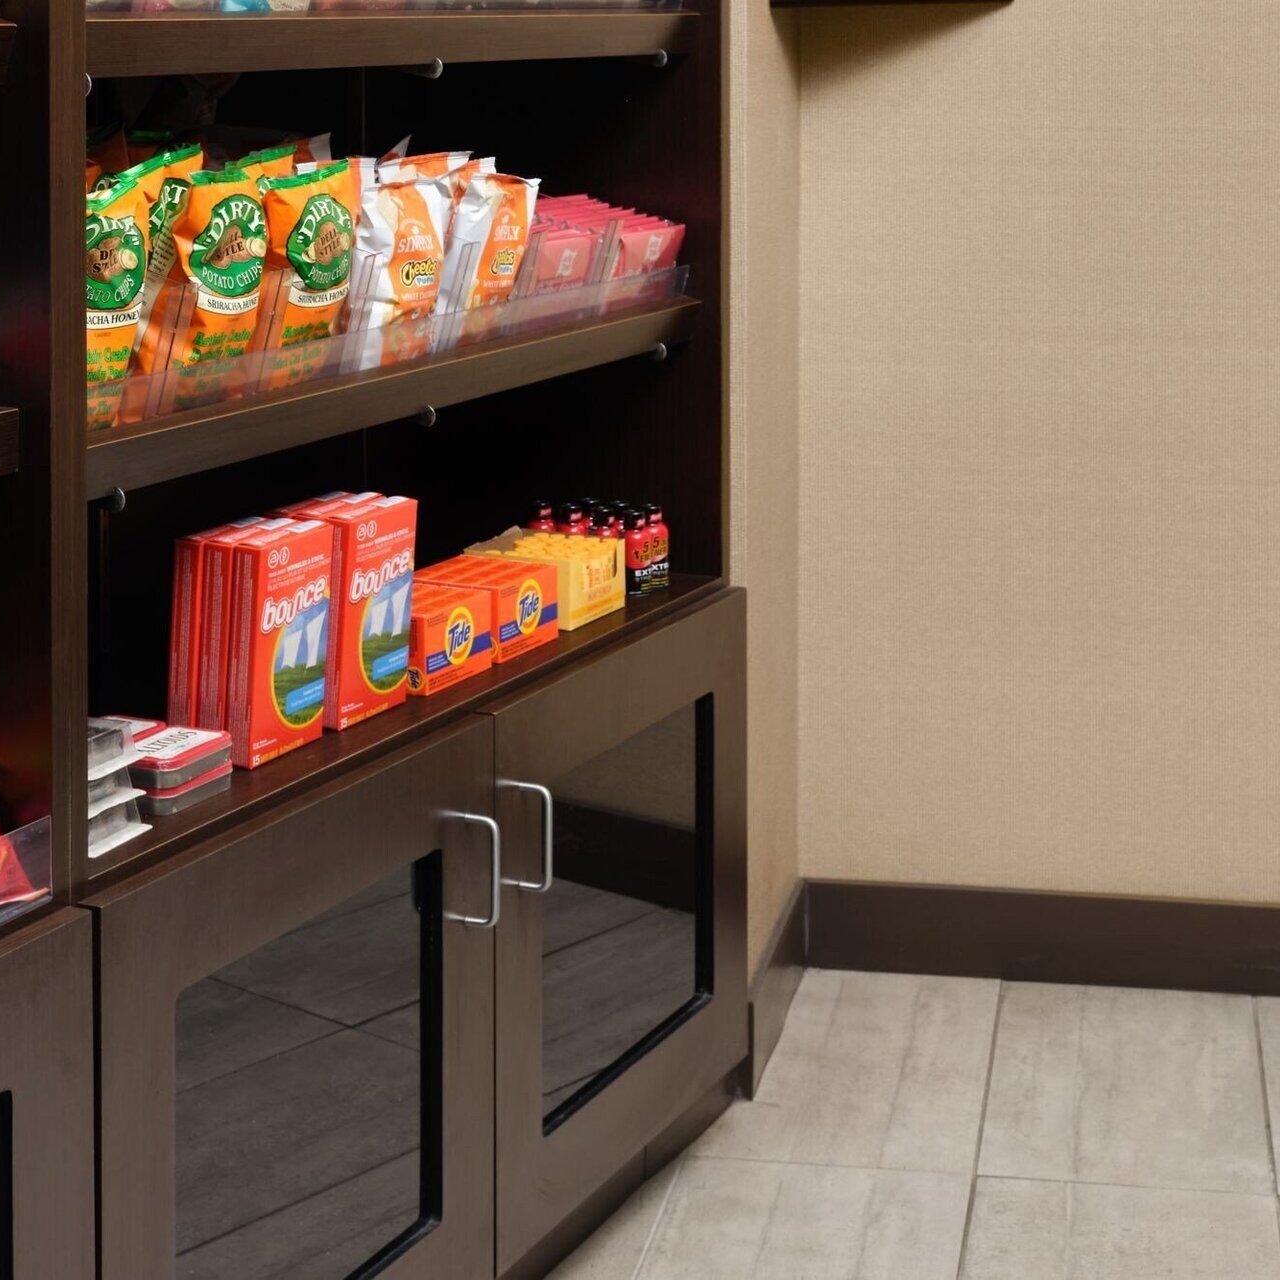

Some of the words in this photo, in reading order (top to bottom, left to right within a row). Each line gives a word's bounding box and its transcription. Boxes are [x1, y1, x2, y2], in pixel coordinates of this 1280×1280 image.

[202, 266, 235, 290] POTATO
[237, 262, 264, 287] CHIPS
[114, 275, 136, 302] CHIPS
[297, 291, 329, 304] SRIRACHA
[207, 298, 243, 311] SRIRACHA
[642, 540, 650, 554] 5
[652, 536, 660, 549] 5
[349, 548, 412, 604] bounce
[262, 575, 328, 635] bounce
[519, 593, 540, 628] Tide
[448, 620, 471, 658] Tide
[408, 668, 419, 689] Tide
[340, 717, 348, 729] 15
[252, 754, 261, 767] 15
